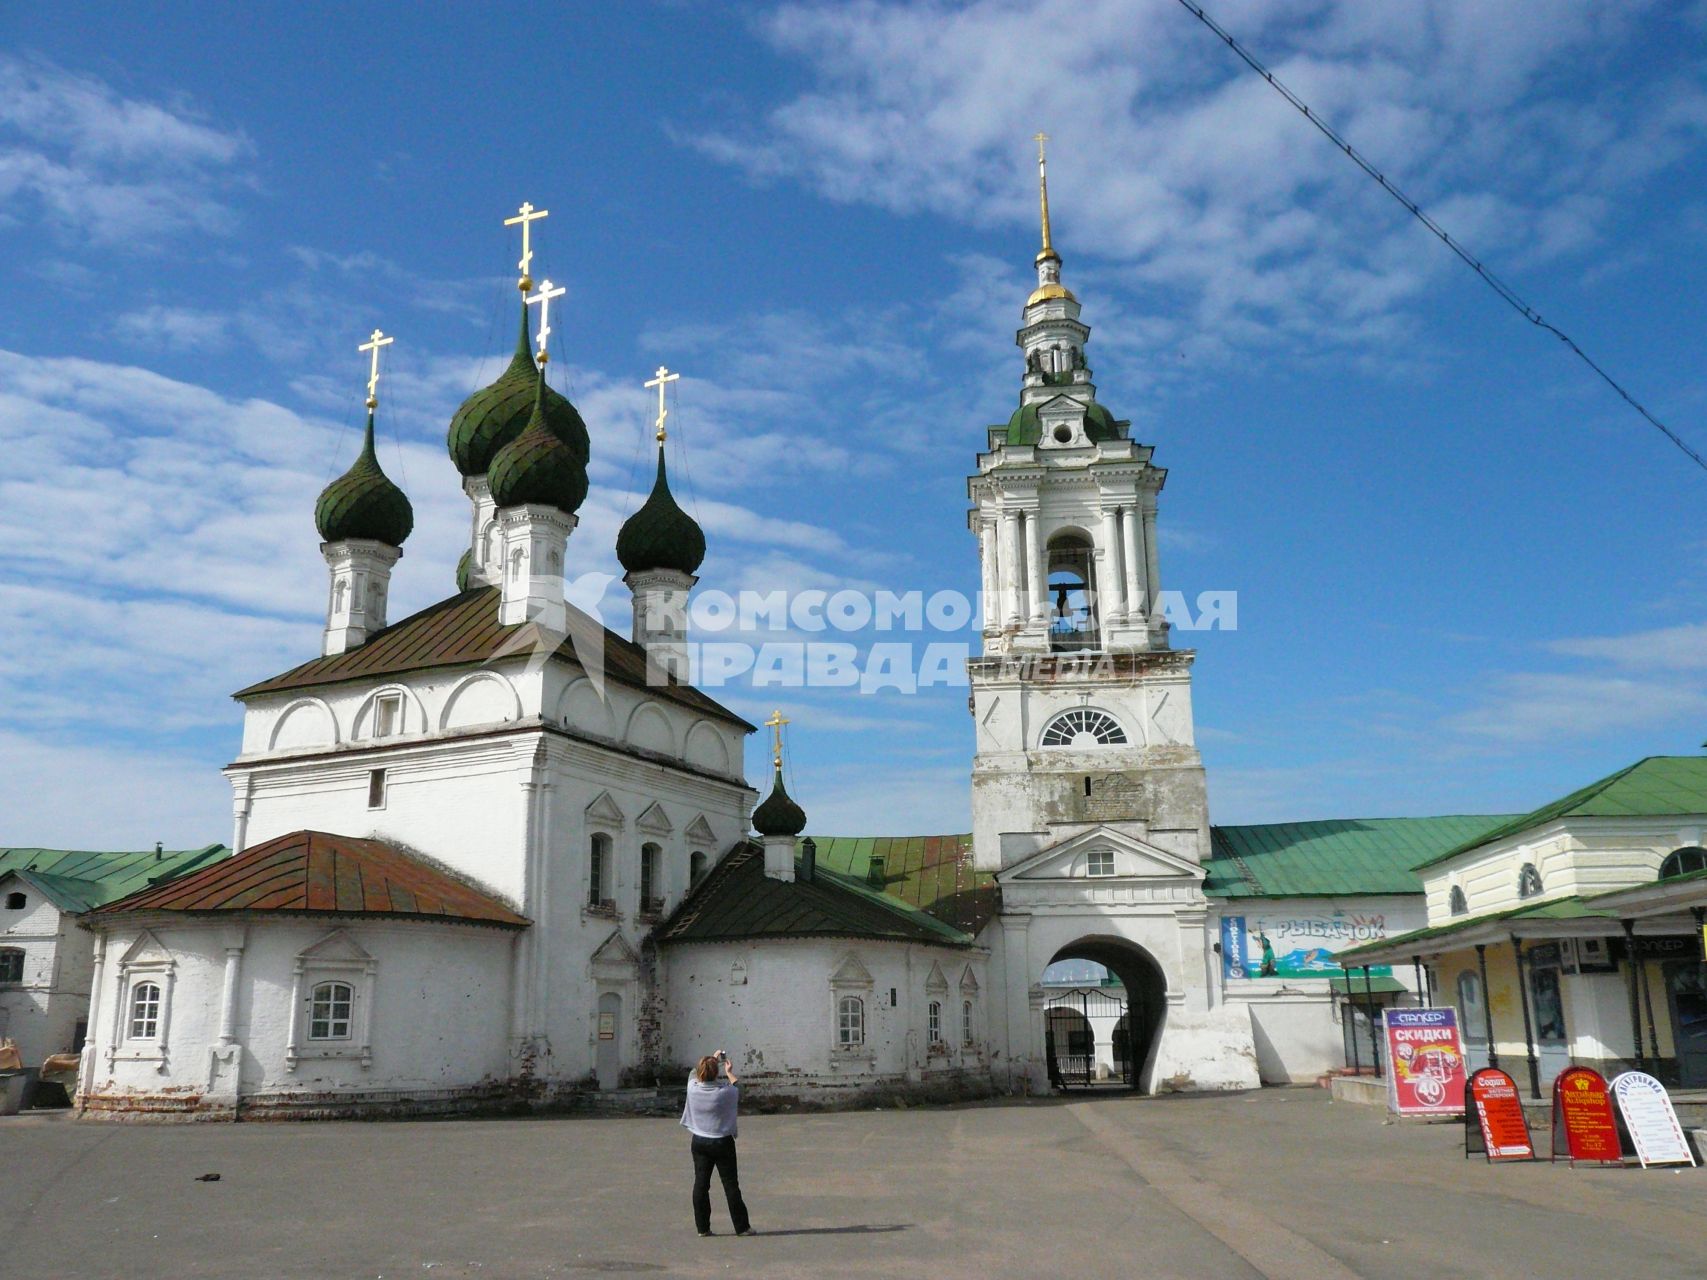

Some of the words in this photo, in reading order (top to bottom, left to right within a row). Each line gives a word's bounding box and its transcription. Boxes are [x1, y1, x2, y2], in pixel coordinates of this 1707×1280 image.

[1277, 919, 1386, 941] РЫБАЧОК
[1395, 1029, 1452, 1042] СКИДКИ
[1418, 1081, 1440, 1097] 40
